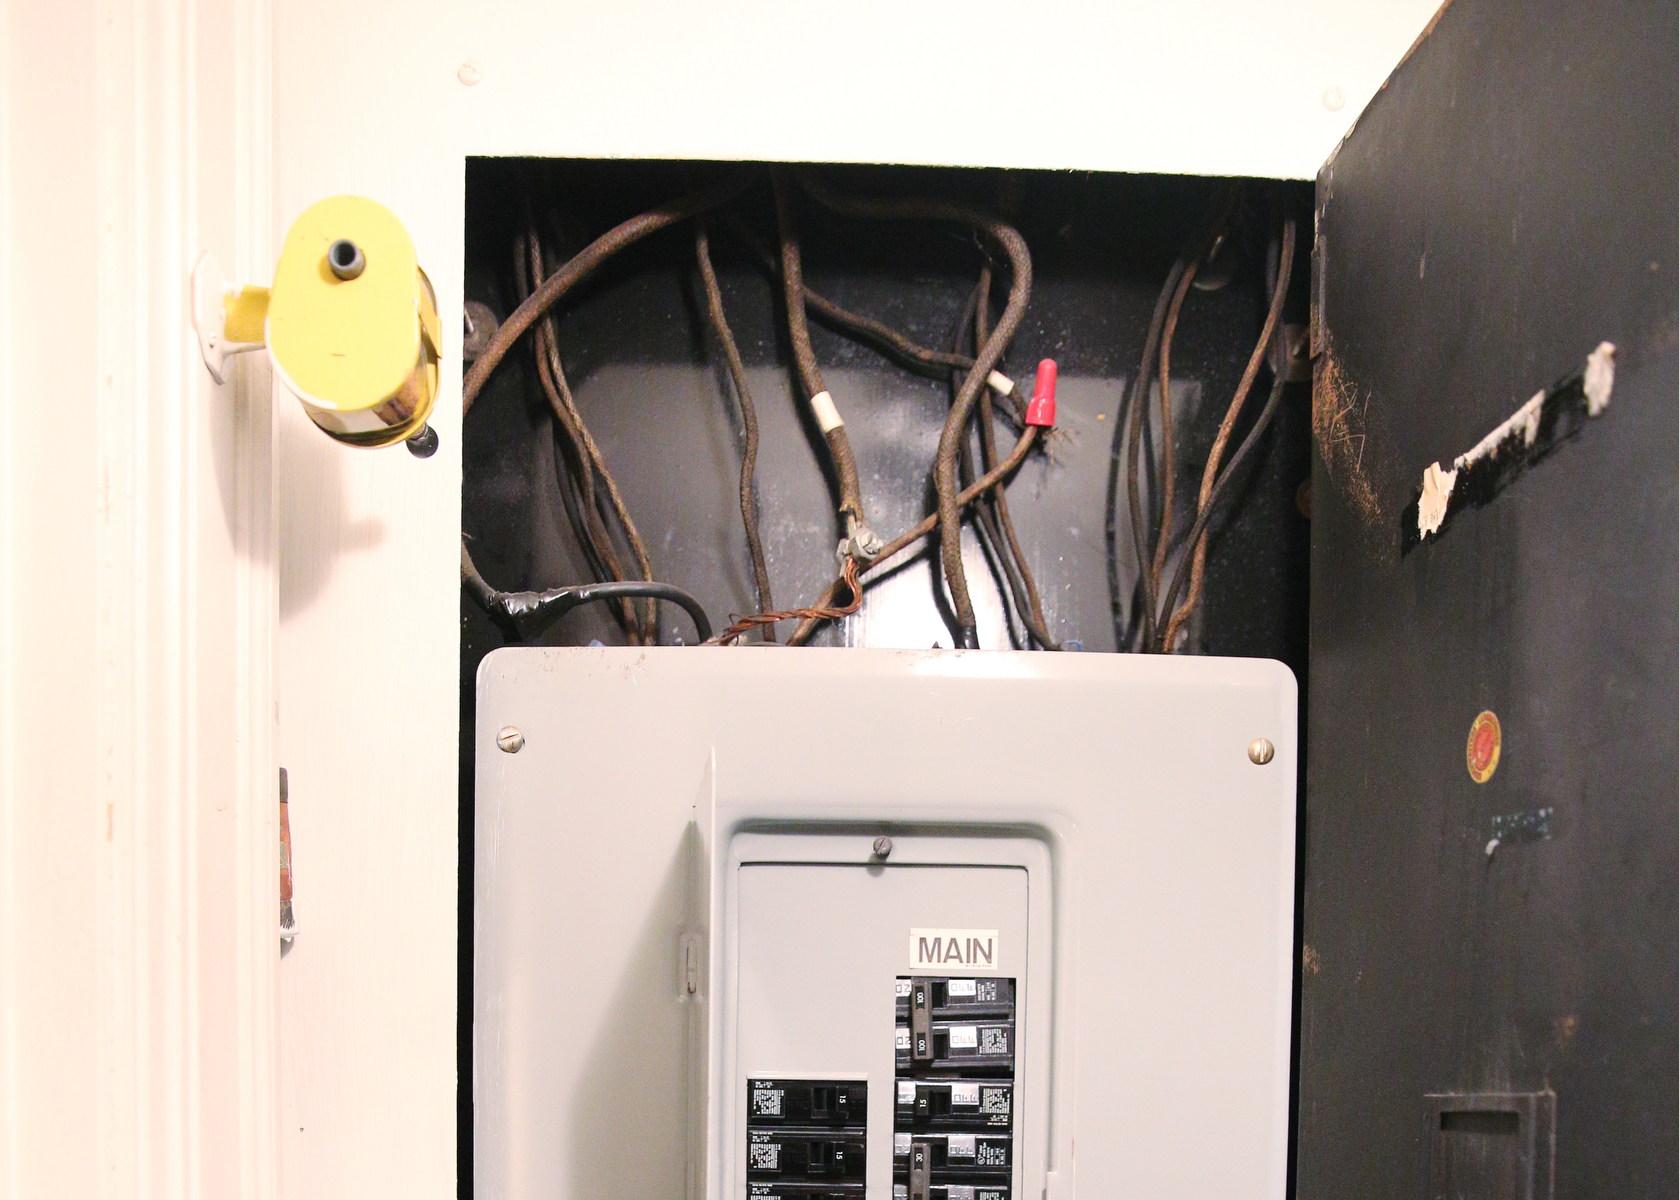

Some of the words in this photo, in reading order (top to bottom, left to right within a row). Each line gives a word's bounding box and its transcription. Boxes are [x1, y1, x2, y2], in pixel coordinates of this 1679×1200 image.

[919, 937, 992, 964] MAIN
[839, 1095, 847, 1104] 15
[919, 1099, 927, 1108] 15
[836, 1151, 843, 1160] 15
[915, 1153, 923, 1162] 30
